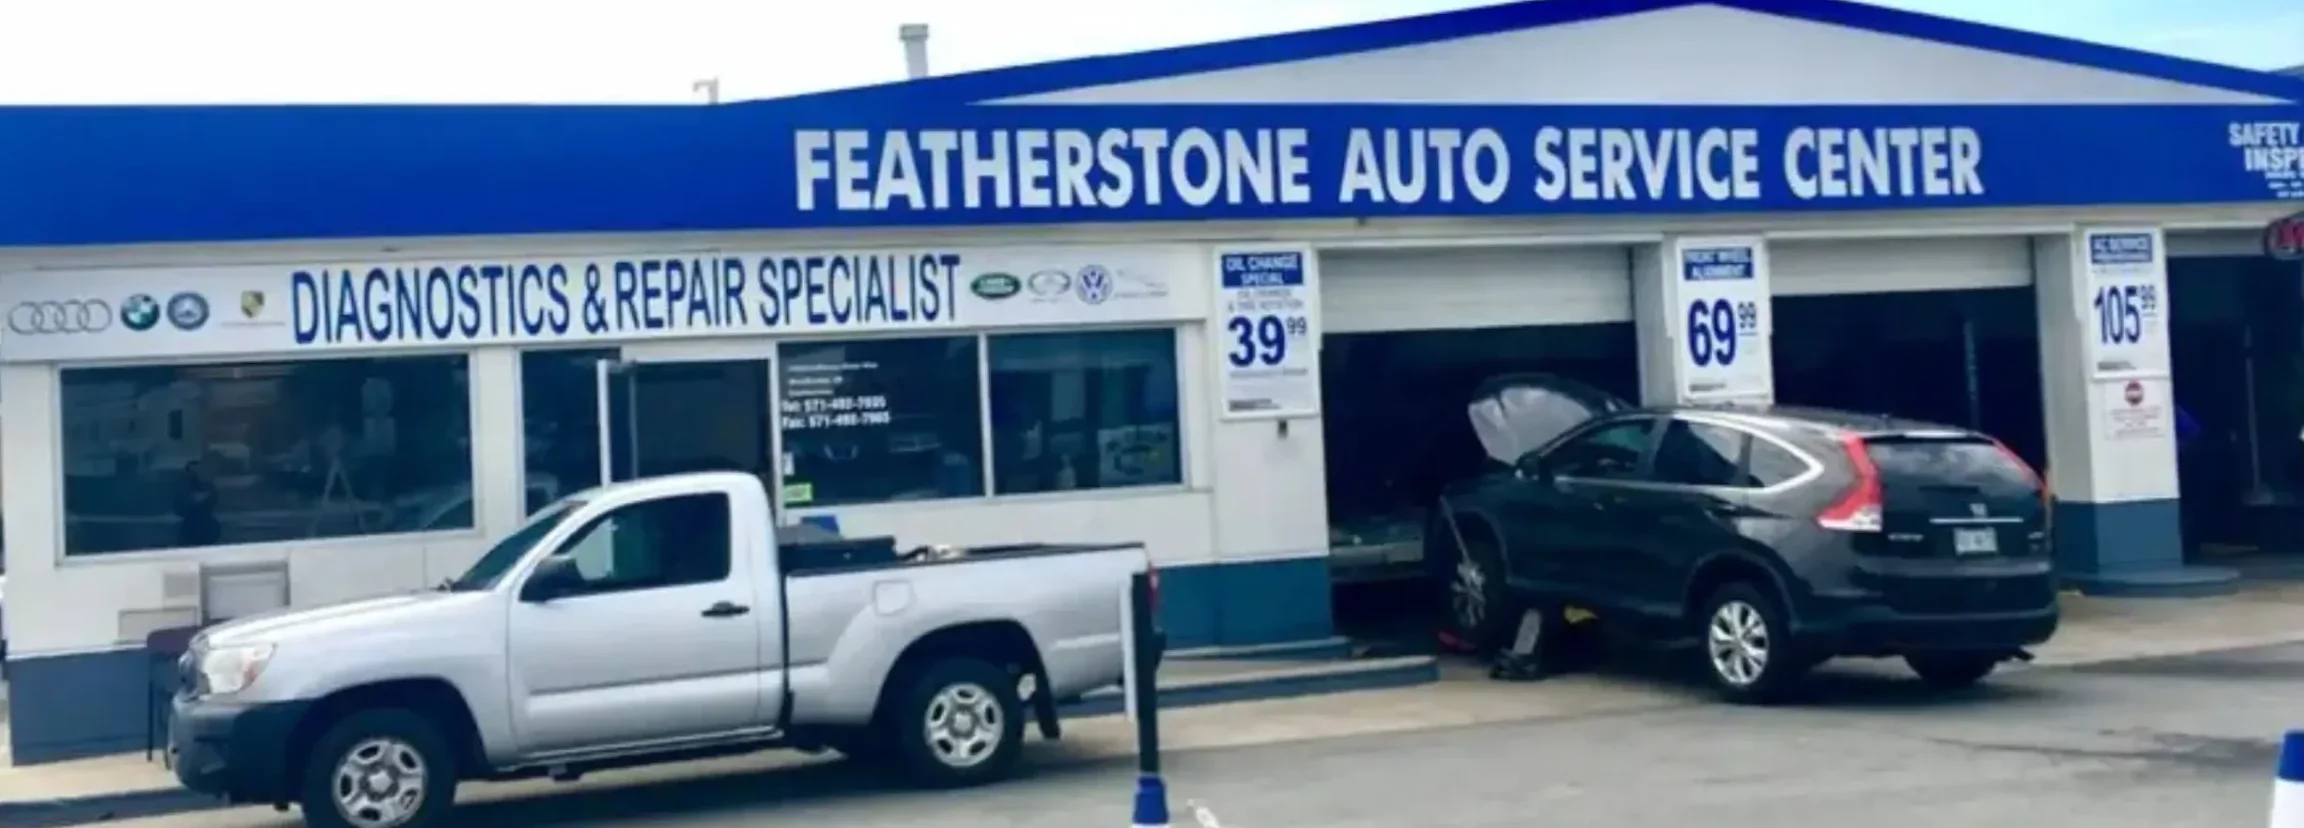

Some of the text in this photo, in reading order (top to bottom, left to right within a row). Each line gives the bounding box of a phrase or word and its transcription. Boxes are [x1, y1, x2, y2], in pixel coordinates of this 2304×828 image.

[2228, 122, 2299, 146] SAFETY
[795, 126, 1985, 210] FEATHERSTONE AUTO SERVICE CENTER
[1225, 254, 1298, 271] OIL CHANGE
[1240, 271, 1285, 285] SPECIAL
[291, 253, 961, 344] DIAGNOSTICS & REPAIR SPECIALIST
[2094, 284, 2157, 345] 105 99
[1228, 314, 1307, 368] 39 99
[1687, 298, 1757, 368] 69 99
